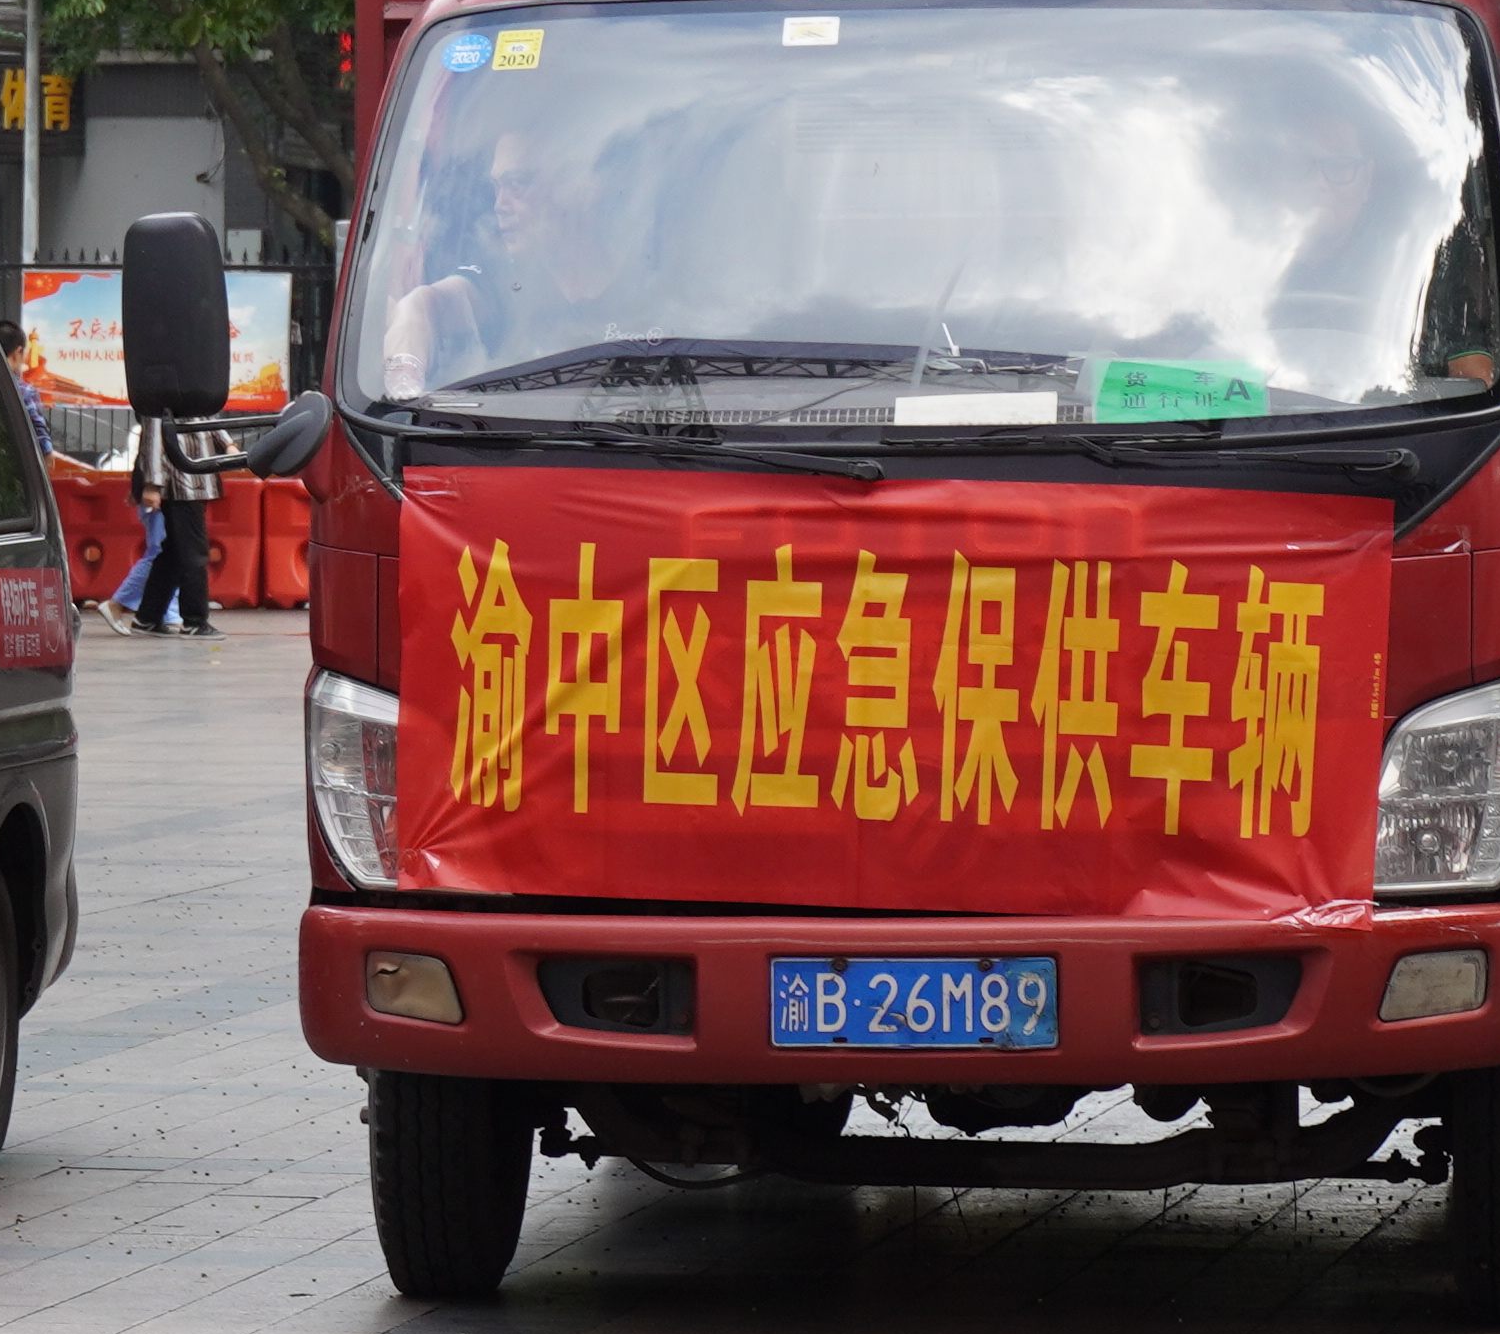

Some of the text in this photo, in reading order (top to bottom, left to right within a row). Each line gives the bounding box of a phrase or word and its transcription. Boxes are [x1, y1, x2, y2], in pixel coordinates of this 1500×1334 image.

[451, 51, 481, 64] 2020
[498, 54, 535, 67] 2020
[1223, 377, 1251, 401] A
[1121, 392, 1220, 409] 通行证
[449, 539, 1326, 839] 渝中区应急保供车辆
